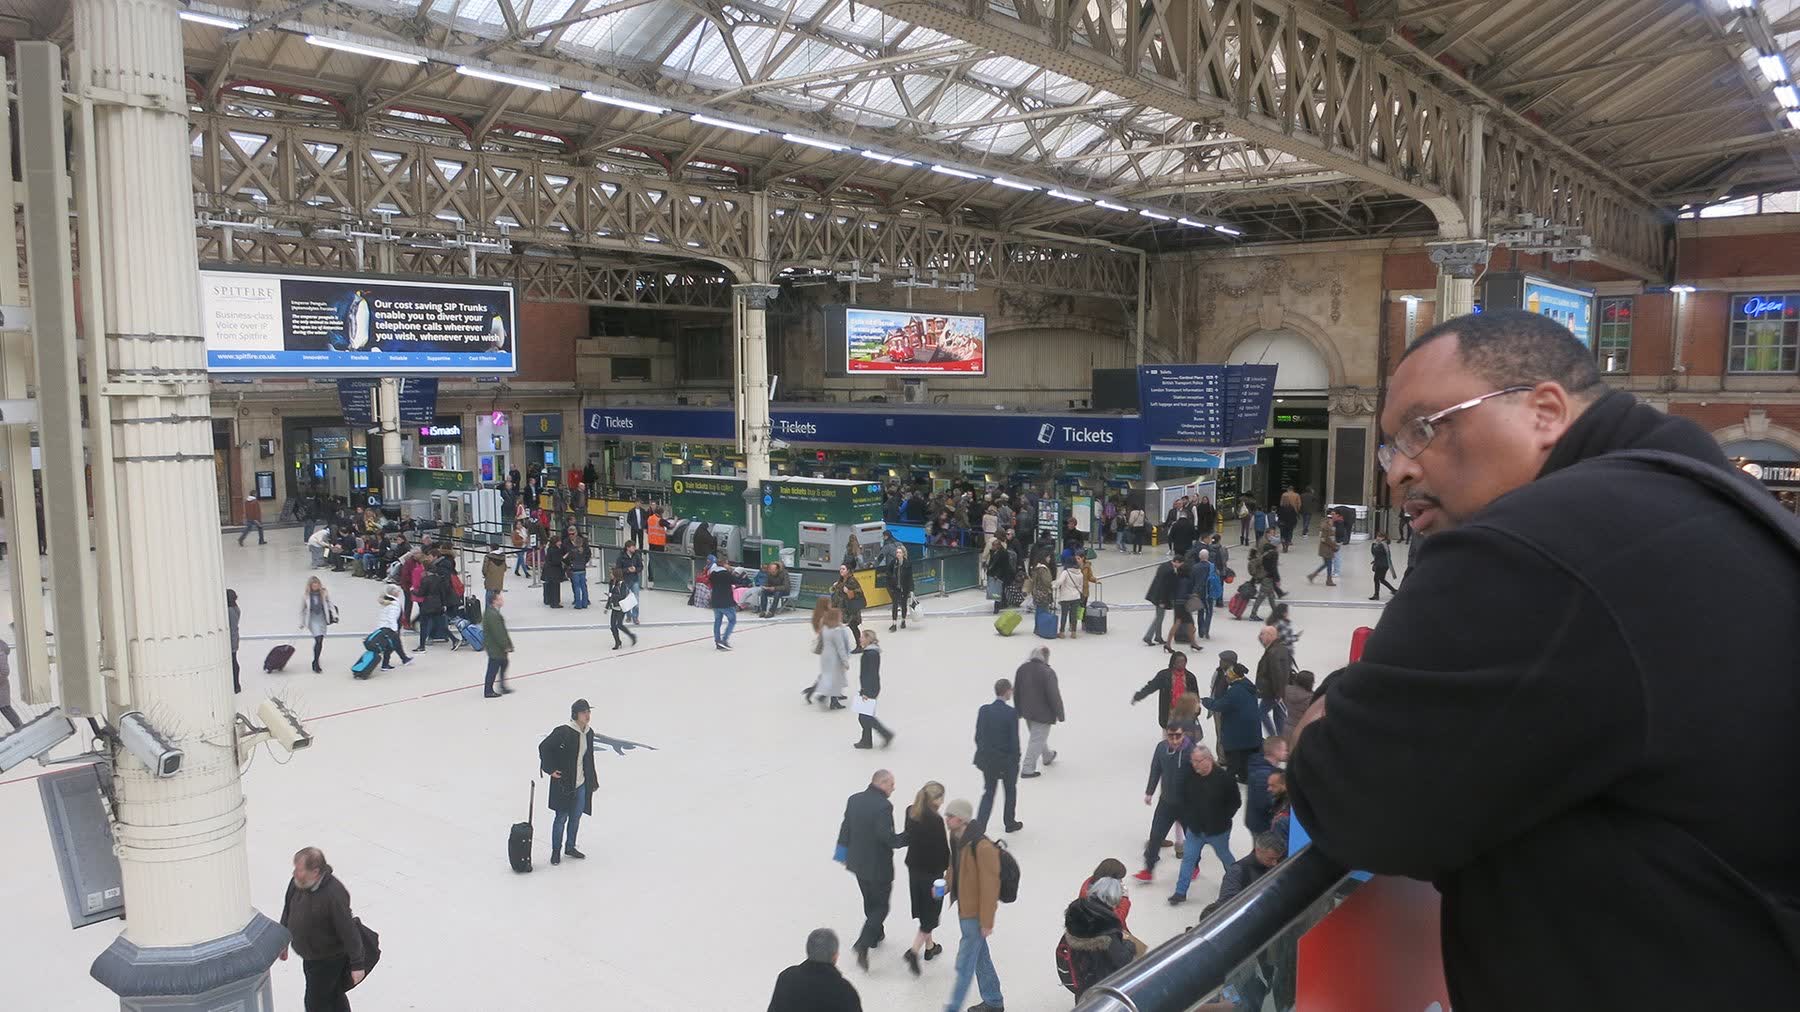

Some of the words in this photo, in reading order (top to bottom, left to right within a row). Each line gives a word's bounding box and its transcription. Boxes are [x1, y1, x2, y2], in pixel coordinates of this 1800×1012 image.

[213, 286, 274, 297] SPITFIRE
[374, 299, 393, 309] Our
[394, 301, 413, 310] cost
[414, 301, 443, 313] saving
[444, 302, 458, 311] SIP
[459, 303, 488, 312] Trunks
[1743, 297, 1783, 318] Open
[216, 311, 274, 320] Business-class
[374, 311, 406, 320] enable
[408, 313, 424, 322] you
[437, 312, 463, 321] divert
[464, 315, 483, 324] your
[216, 321, 238, 329] Voice
[375, 321, 421, 332] telephone
[422, 322, 442, 331] calls
[443, 323, 484, 332] wherever
[375, 333, 393, 342] you
[394, 332, 418, 341] wish,
[420, 332, 463, 341] whenever
[464, 335, 480, 344] you
[481, 334, 500, 342] wish
[604, 416, 634, 429] Tickets
[780, 420, 817, 434] Tickets
[430, 425, 461, 436] iSmash
[1062, 426, 1114, 443] Tickets
[780, 486, 791, 494] Train
[791, 487, 807, 495] tickets
